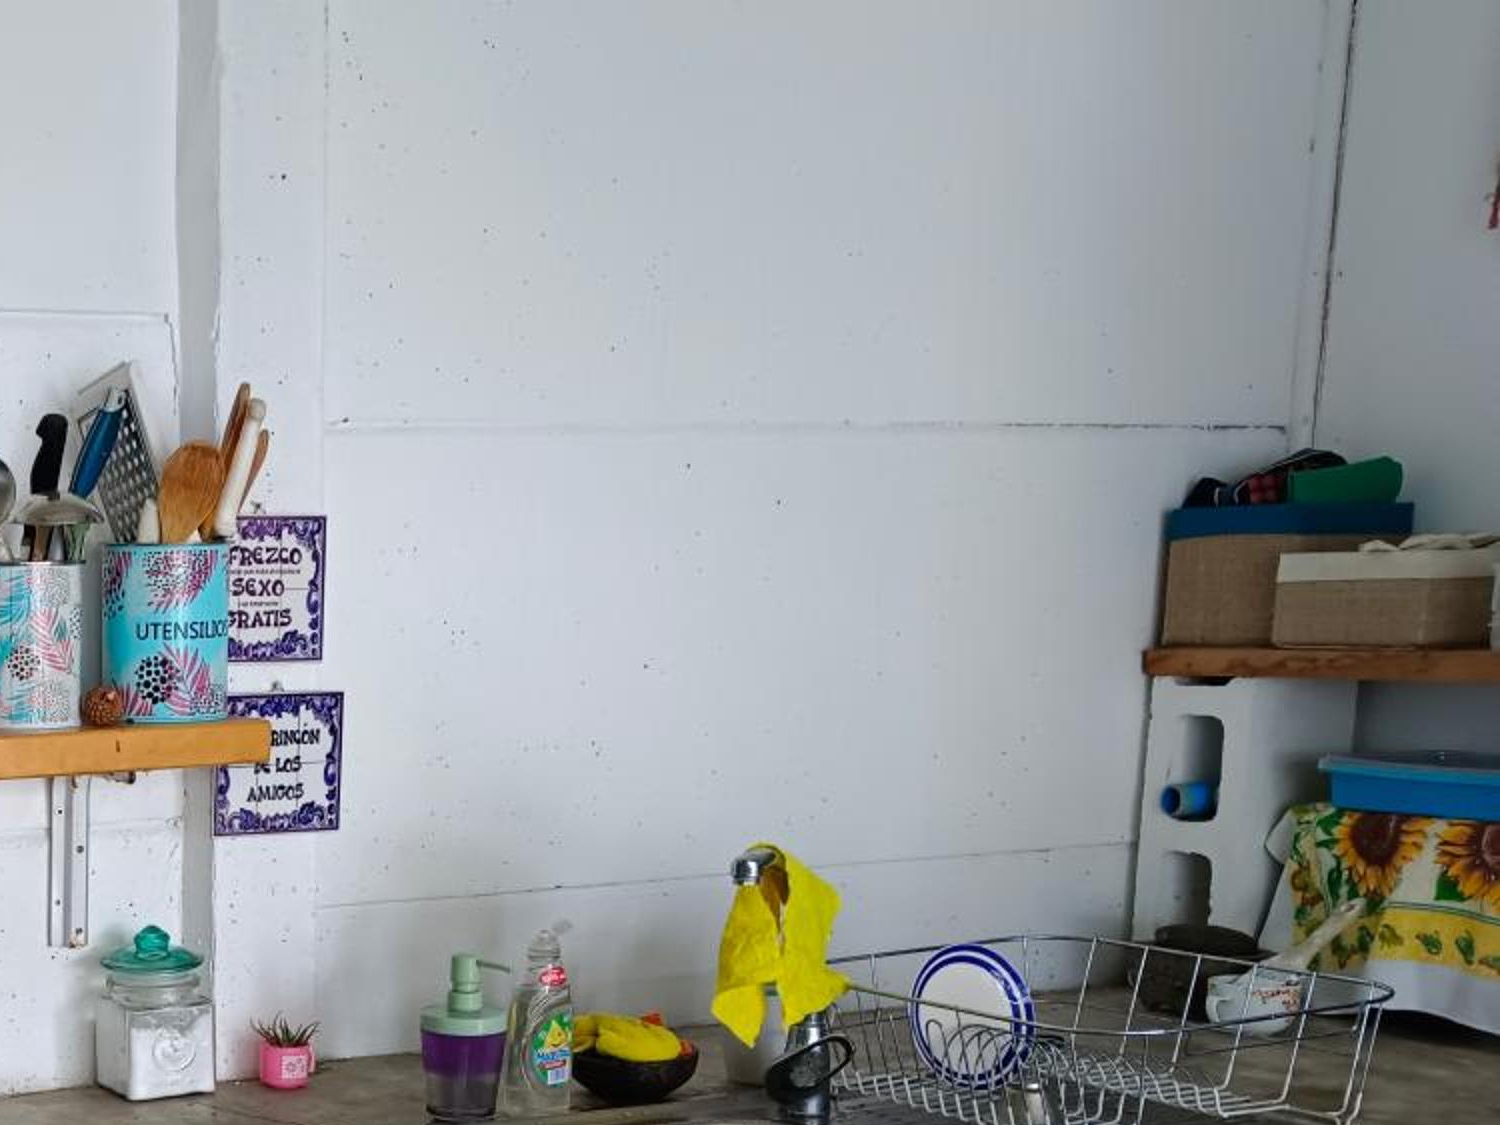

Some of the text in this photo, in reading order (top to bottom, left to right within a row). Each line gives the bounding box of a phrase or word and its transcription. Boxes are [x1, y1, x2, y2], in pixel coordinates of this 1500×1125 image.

[229, 545, 302, 566] FREZCO
[232, 577, 285, 597] SEXO
[275, 756, 302, 772] LOS
[247, 782, 304, 802] AMIGOS
